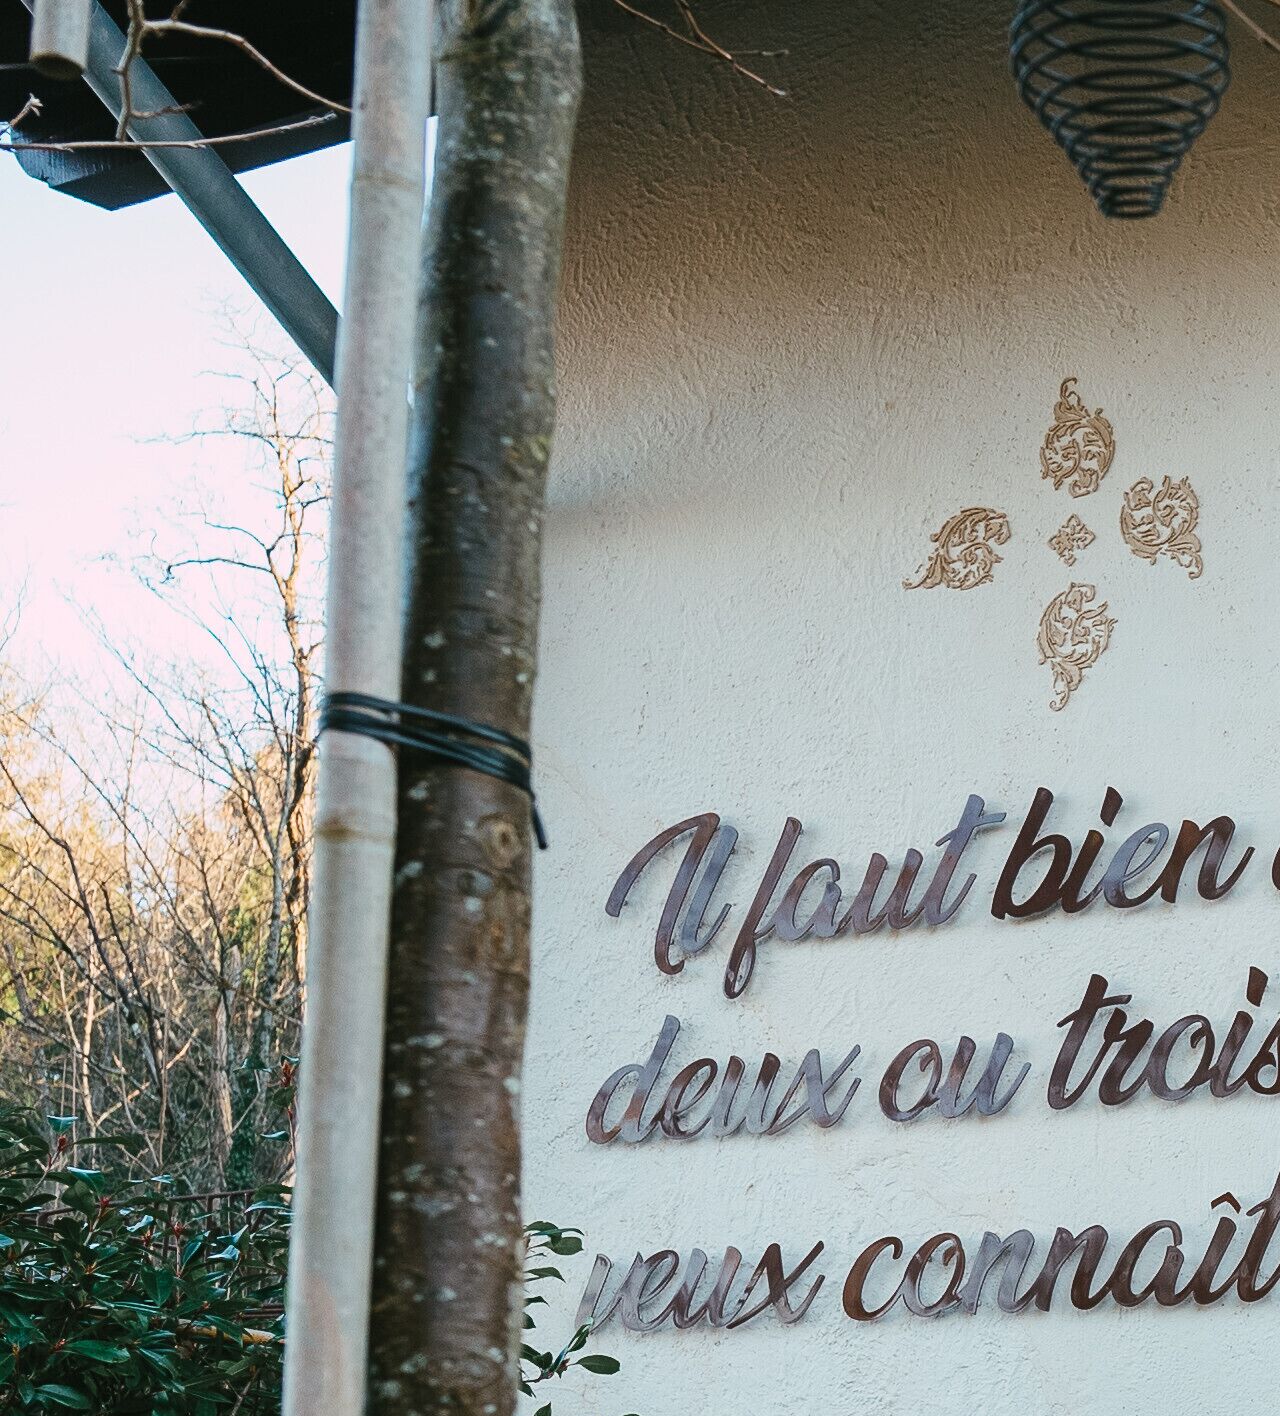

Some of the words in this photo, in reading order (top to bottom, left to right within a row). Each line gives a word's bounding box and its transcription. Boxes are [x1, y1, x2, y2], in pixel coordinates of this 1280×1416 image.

[604, 811, 738, 975] Il
[723, 794, 1006, 1000] faut
[990, 786, 1255, 921] bien
[586, 1014, 862, 1144] deux
[879, 1032, 1031, 1122] ou
[574, 1240, 825, 1334] veux
